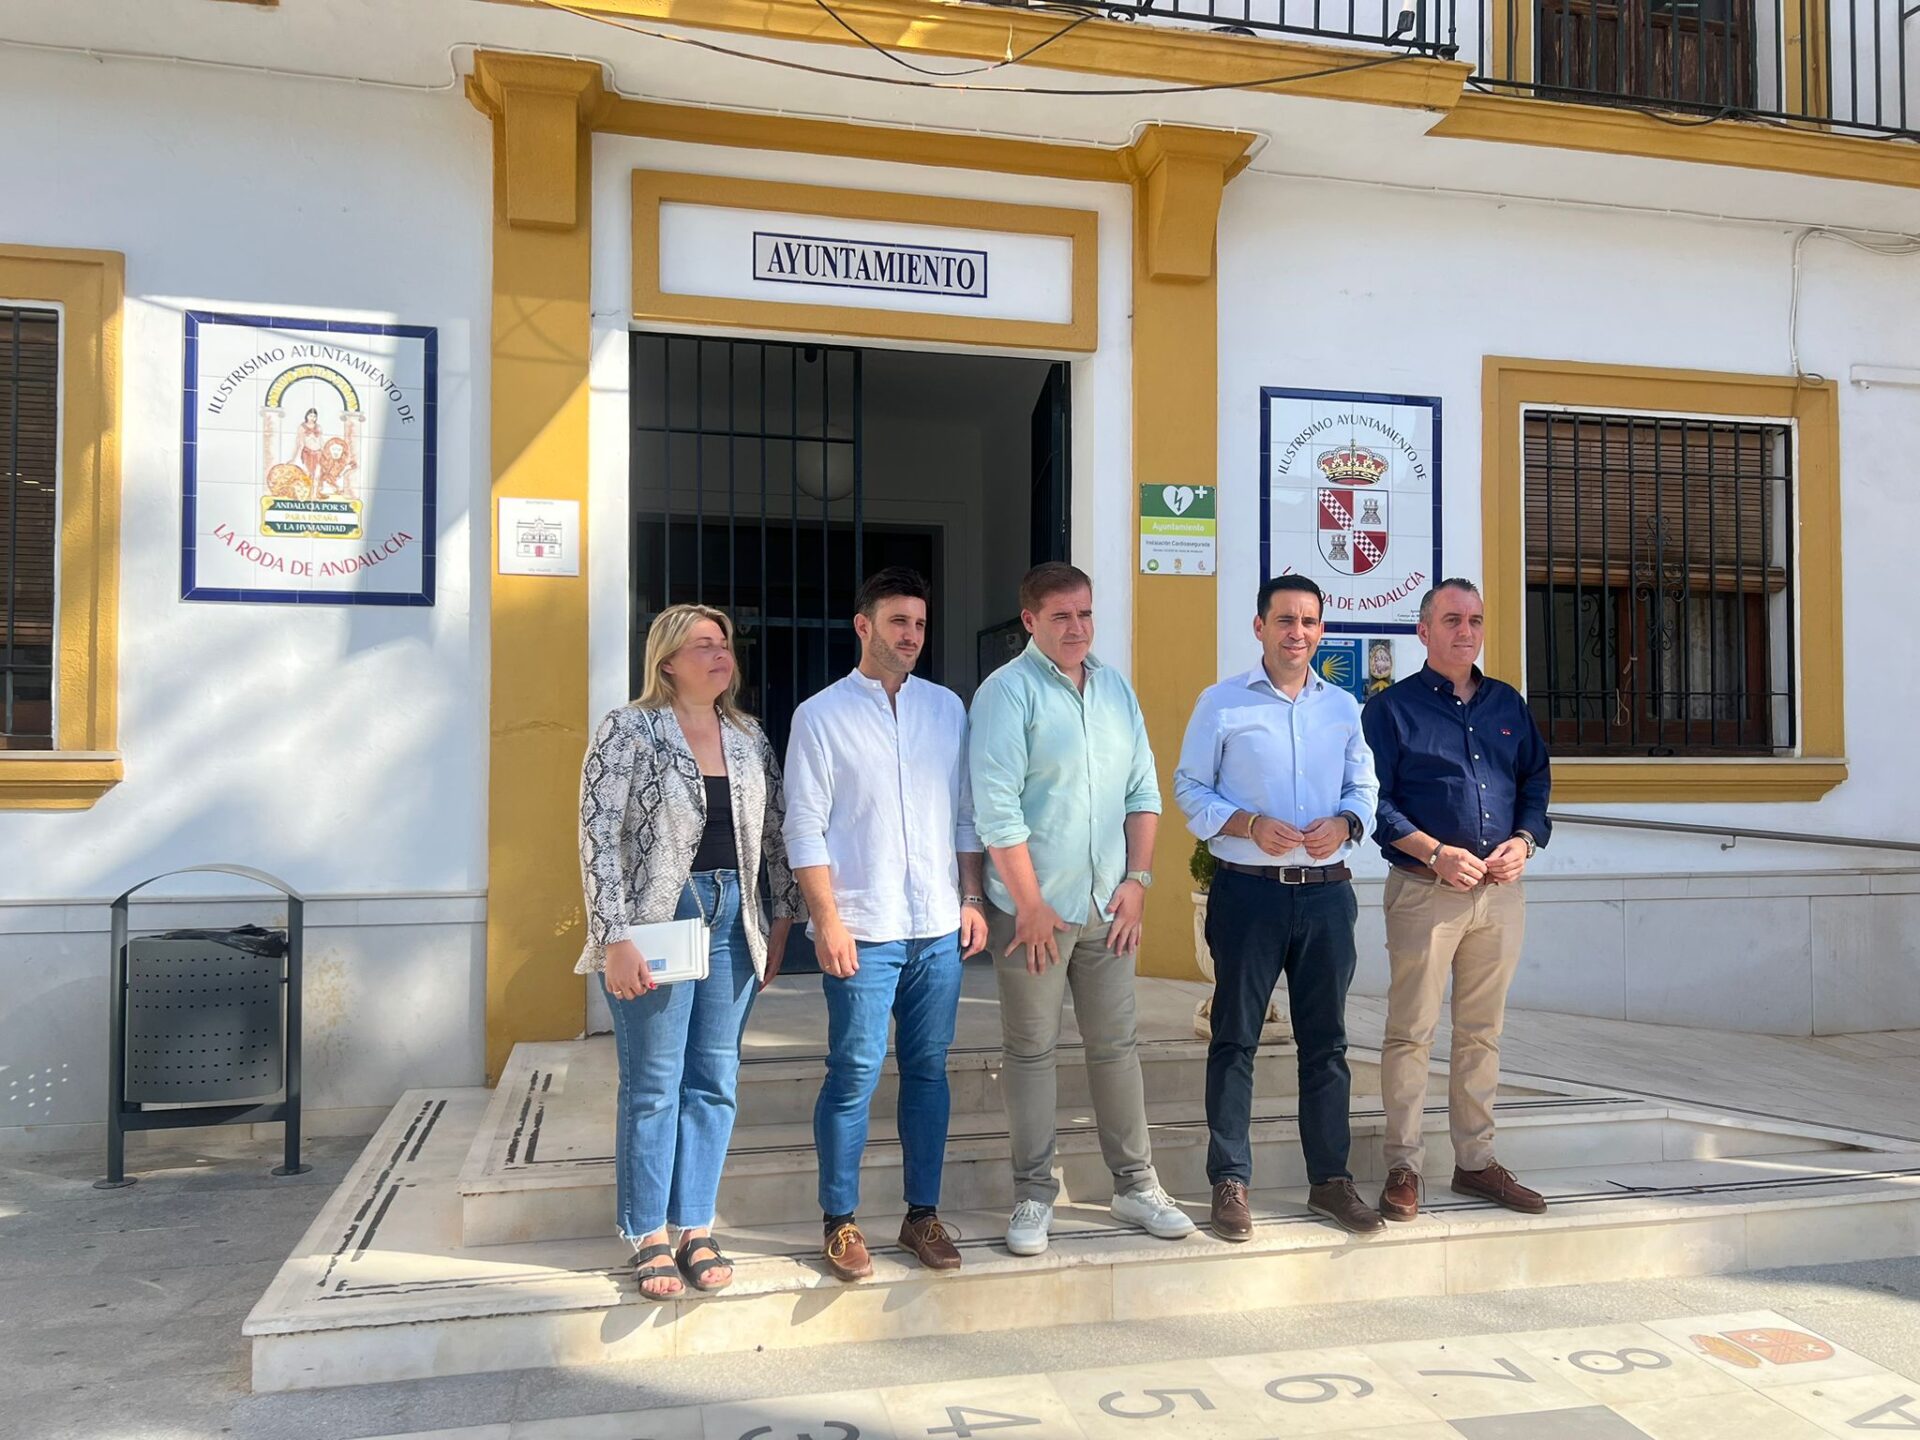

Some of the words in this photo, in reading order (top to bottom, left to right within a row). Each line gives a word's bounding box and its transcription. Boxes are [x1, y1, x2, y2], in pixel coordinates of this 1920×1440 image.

[767, 241, 976, 290] AYUNTAMIENTO
[208, 348, 285, 414] ILUSTRISIMO
[290, 345, 402, 402] AYUNTAMIENTO
[397, 403, 416, 425] DE
[1277, 417, 1333, 475] ILUSTRISIMO
[1336, 414, 1418, 462] AYUNTAMIENTO
[1413, 463, 1427, 481] DE
[322, 503, 338, 511] POR
[283, 523, 295, 531] LA
[1152, 522, 1205, 532] Ayuntamiento
[213, 523, 234, 547] LA
[235, 540, 284, 573] RODA
[290, 559, 313, 577] DE
[319, 531, 413, 577] ANDALUCÍA
[1337, 596, 1354, 610] DE
[1358, 571, 1425, 610] ANDALUCÍA
[1417, 1358, 1536, 1383] 7
[1567, 1348, 1672, 1375] 8
[1098, 1388, 1216, 1419] 5
[1265, 1373, 1374, 1403] 6
[927, 1405, 1042, 1438] 4
